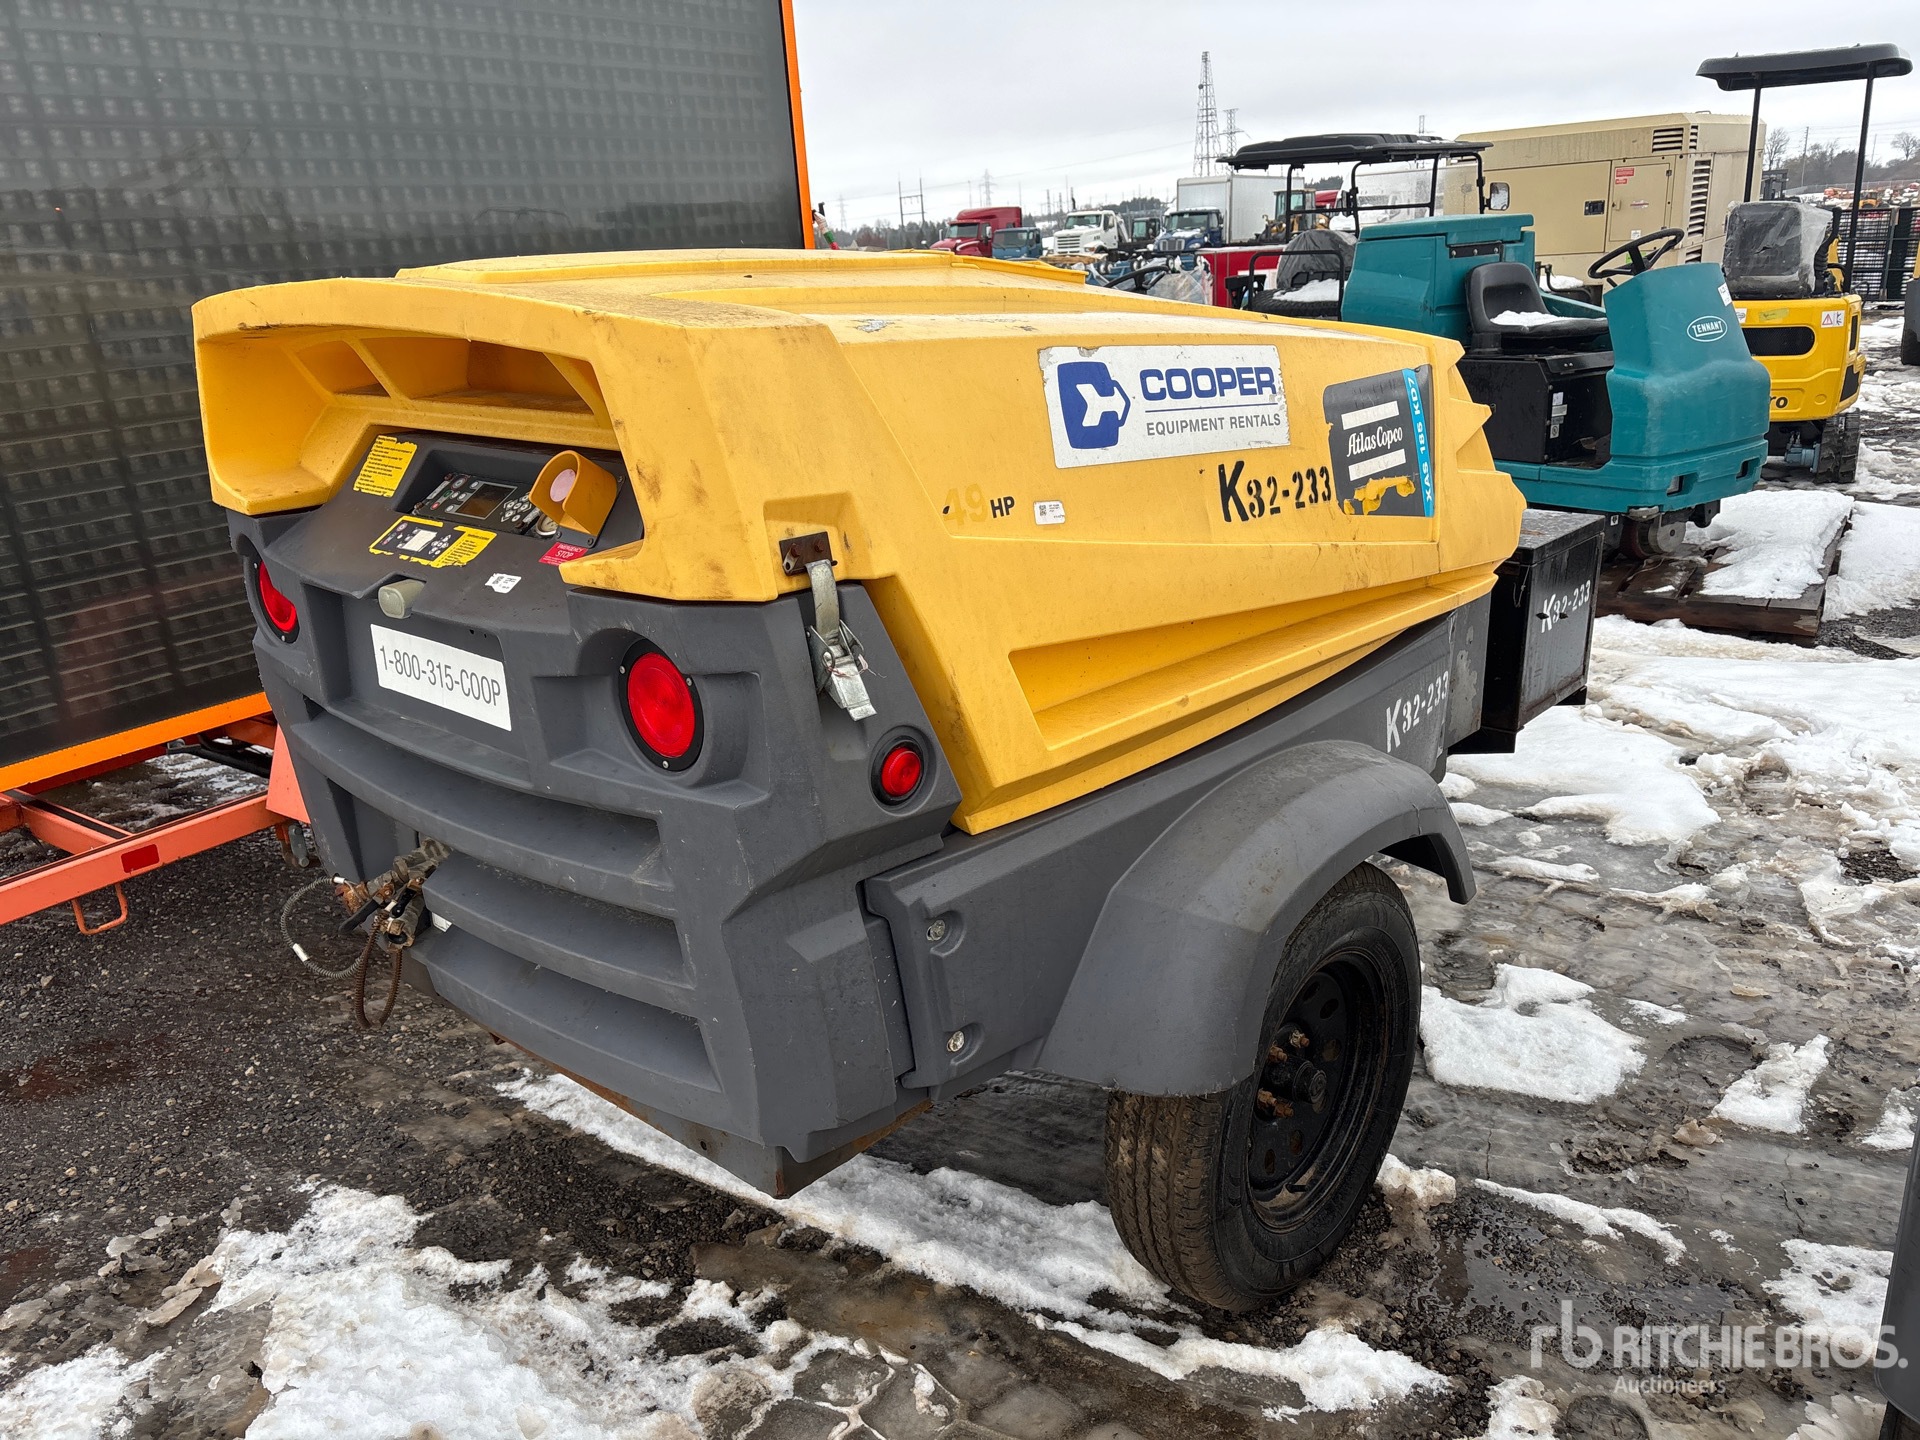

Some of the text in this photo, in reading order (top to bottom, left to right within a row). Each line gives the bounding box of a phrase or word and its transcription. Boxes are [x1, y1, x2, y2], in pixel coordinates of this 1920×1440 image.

[1692, 321, 1724, 338] TENNANT
[1140, 366, 1277, 402] COOPER
[1146, 412, 1281, 437] EQUIPMENT RENTALS
[1407, 377, 1433, 503] XAS 185 KD7
[942, 483, 988, 526] 49
[990, 496, 1015, 519] HP
[1218, 459, 1332, 523] K32-233
[555, 550, 574, 559] STOP
[557, 543, 583, 553] EMERGENCY
[378, 644, 502, 708] 1-800-315-COOP
